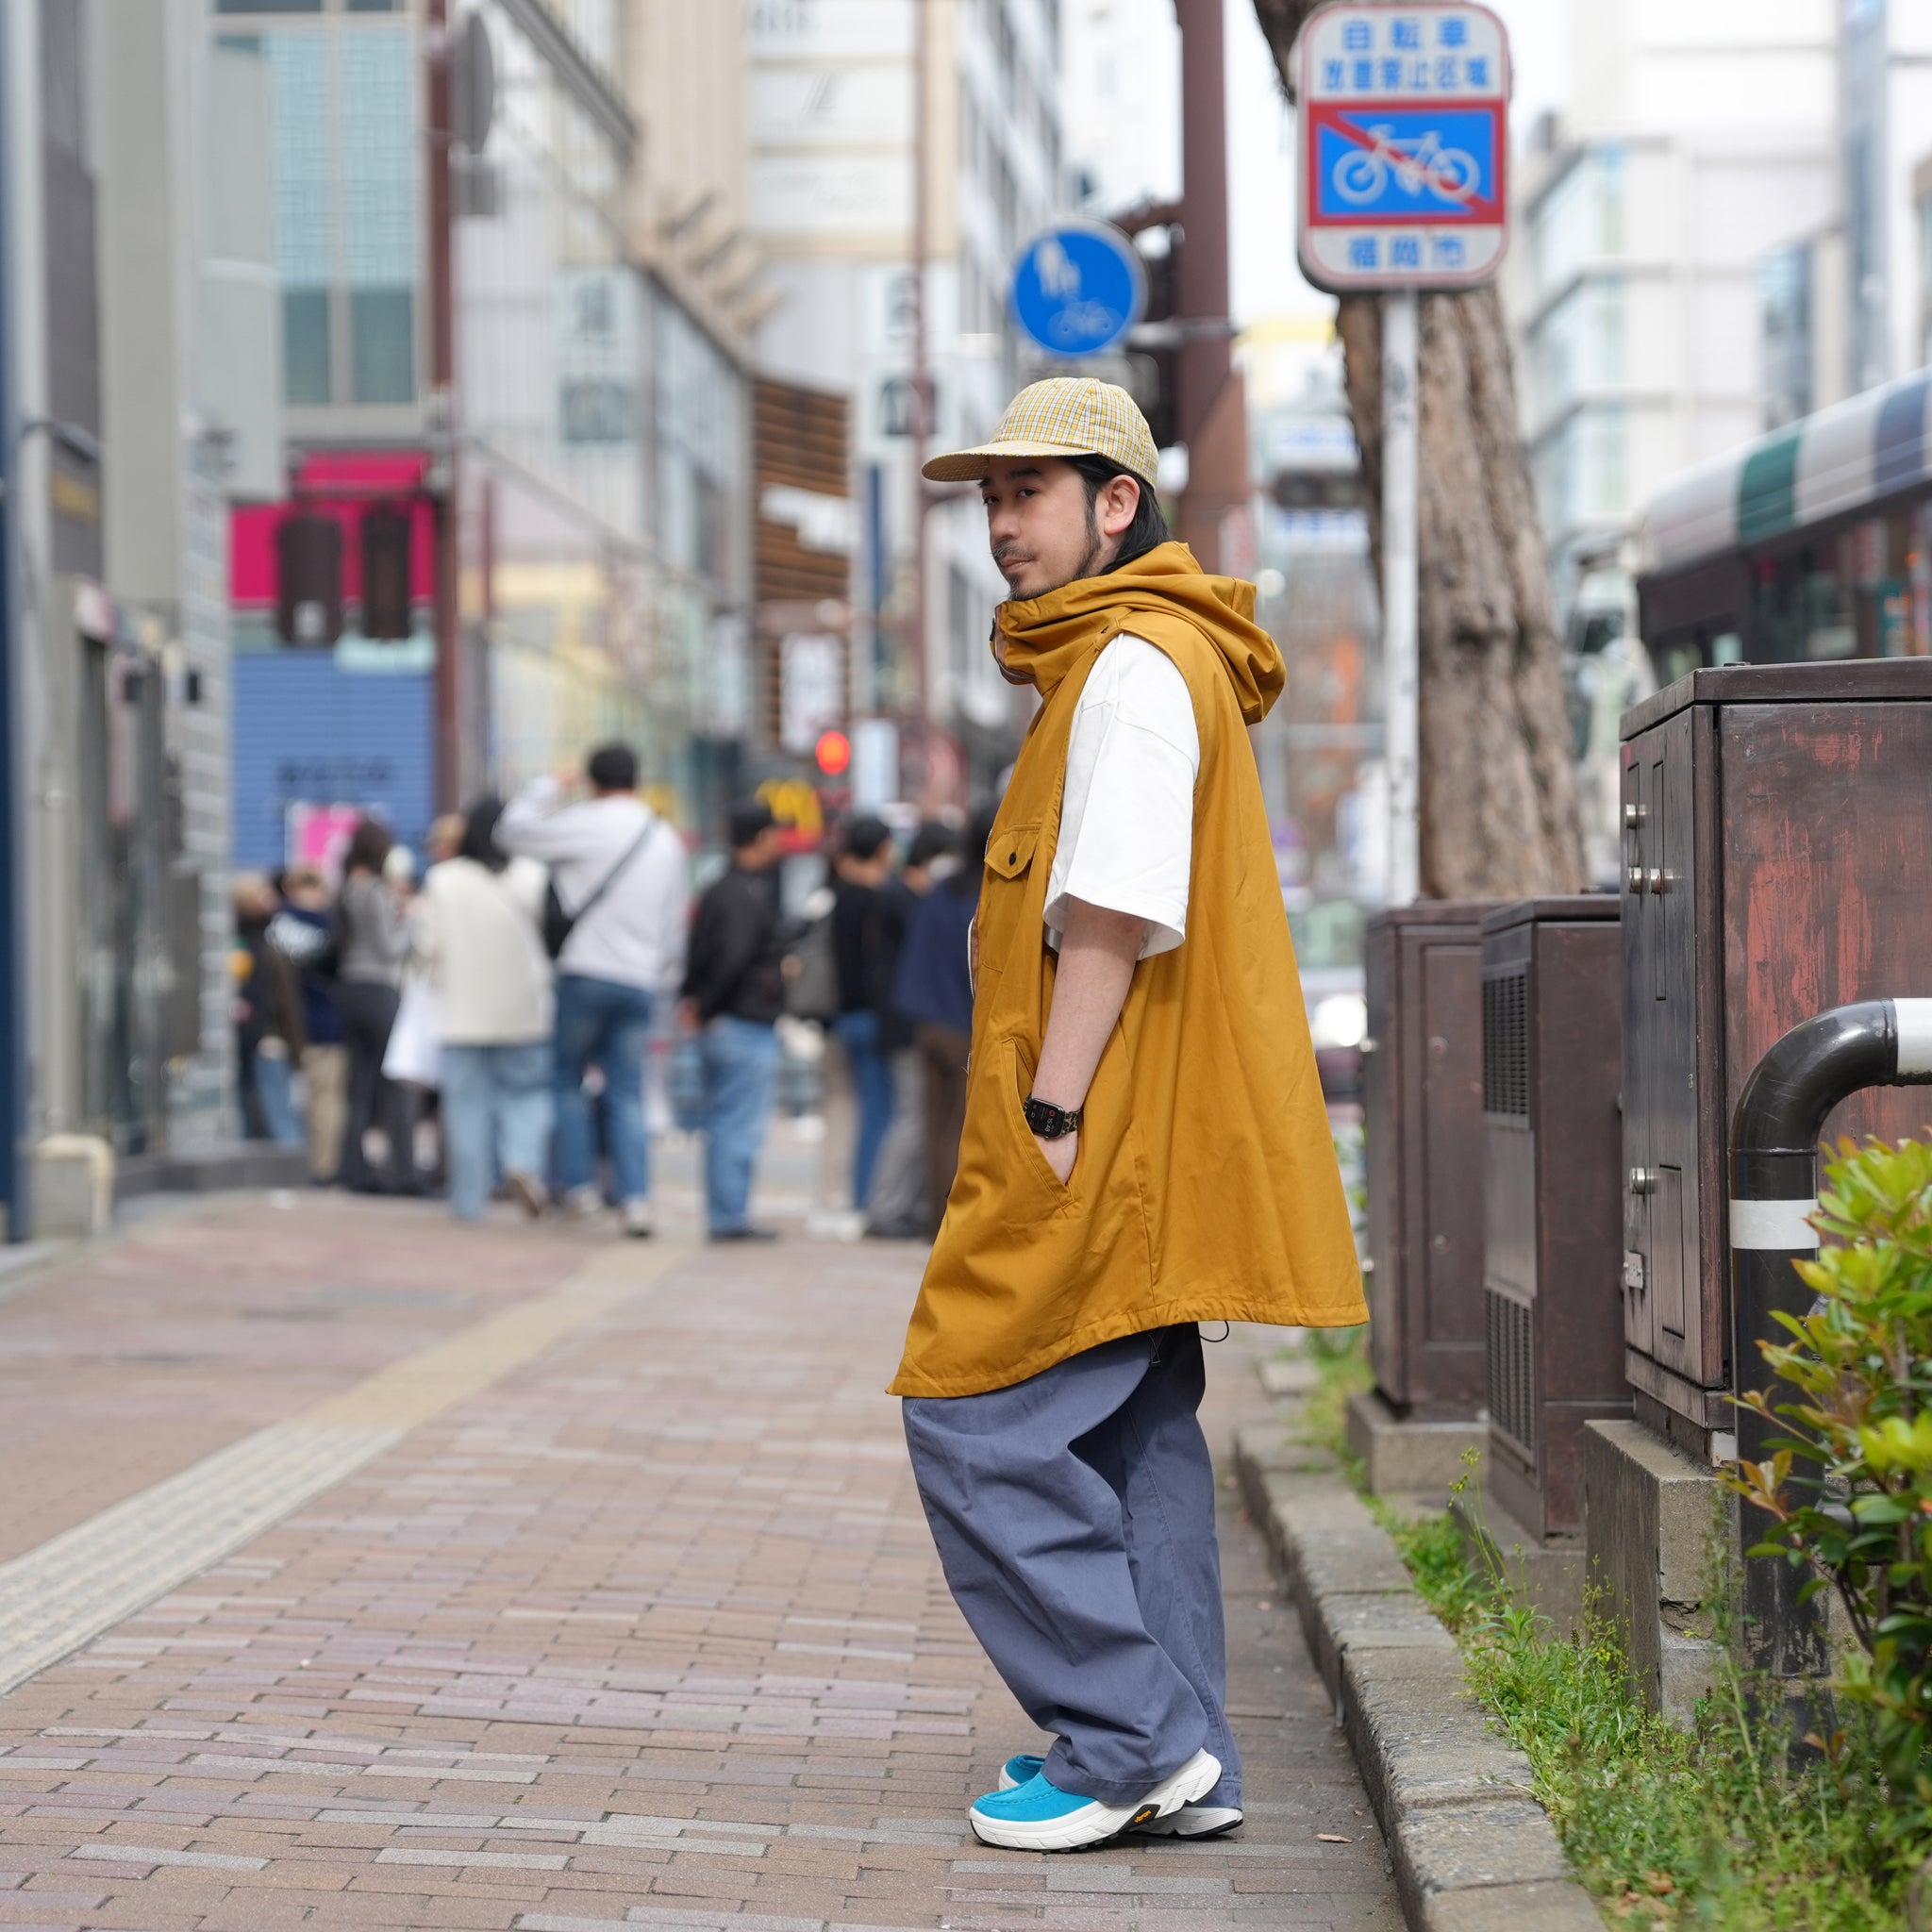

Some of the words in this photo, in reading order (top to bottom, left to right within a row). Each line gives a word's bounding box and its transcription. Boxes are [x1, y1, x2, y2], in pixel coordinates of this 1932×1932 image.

[1343, 18, 1466, 49] 自転車
[1324, 56, 1488, 91] 放置禁止区域
[1347, 235, 1466, 269] 福岡市
